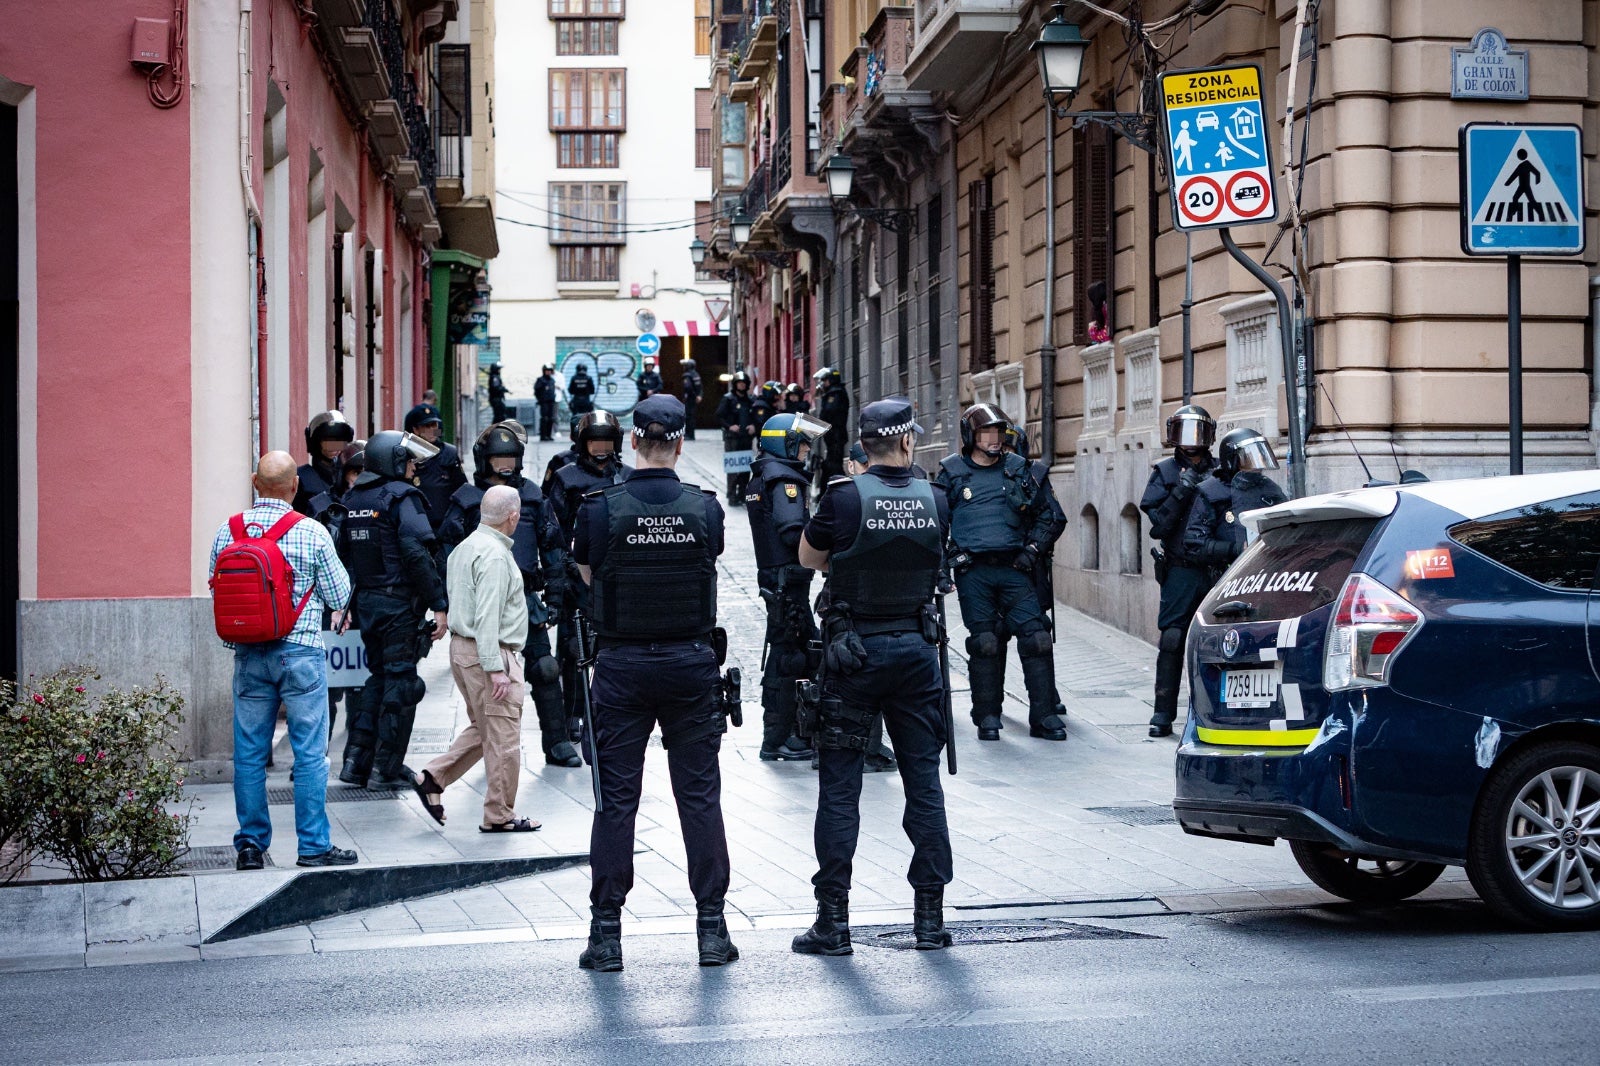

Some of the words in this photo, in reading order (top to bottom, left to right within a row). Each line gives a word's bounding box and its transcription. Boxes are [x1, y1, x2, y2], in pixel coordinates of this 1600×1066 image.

[1475, 56, 1503, 65] CALLE
[1463, 66, 1493, 78] GRAN
[1499, 67, 1516, 79] VIA
[1188, 74, 1233, 89] ZONA
[1464, 79, 1478, 91] DE
[1483, 80, 1516, 92] COLON
[1166, 85, 1258, 105] RESIDENCIAL
[1188, 191, 1214, 208] 20
[724, 456, 753, 467] POLICIA
[875, 499, 925, 511] POLICIA
[348, 509, 374, 518] OLICIA
[887, 511, 915, 519] LOCAL
[637, 516, 685, 527] POLICIA
[866, 517, 937, 530] GRANADA
[648, 526, 675, 534] LOCAL
[626, 532, 696, 544] GRANADA
[1425, 555, 1448, 567] 112
[1217, 569, 1267, 600] POLICÍA
[1264, 572, 1318, 592] LOCAL
[325, 646, 369, 671] OLIC
[1227, 674, 1251, 698] 7259
[1253, 673, 1274, 697] LLL
